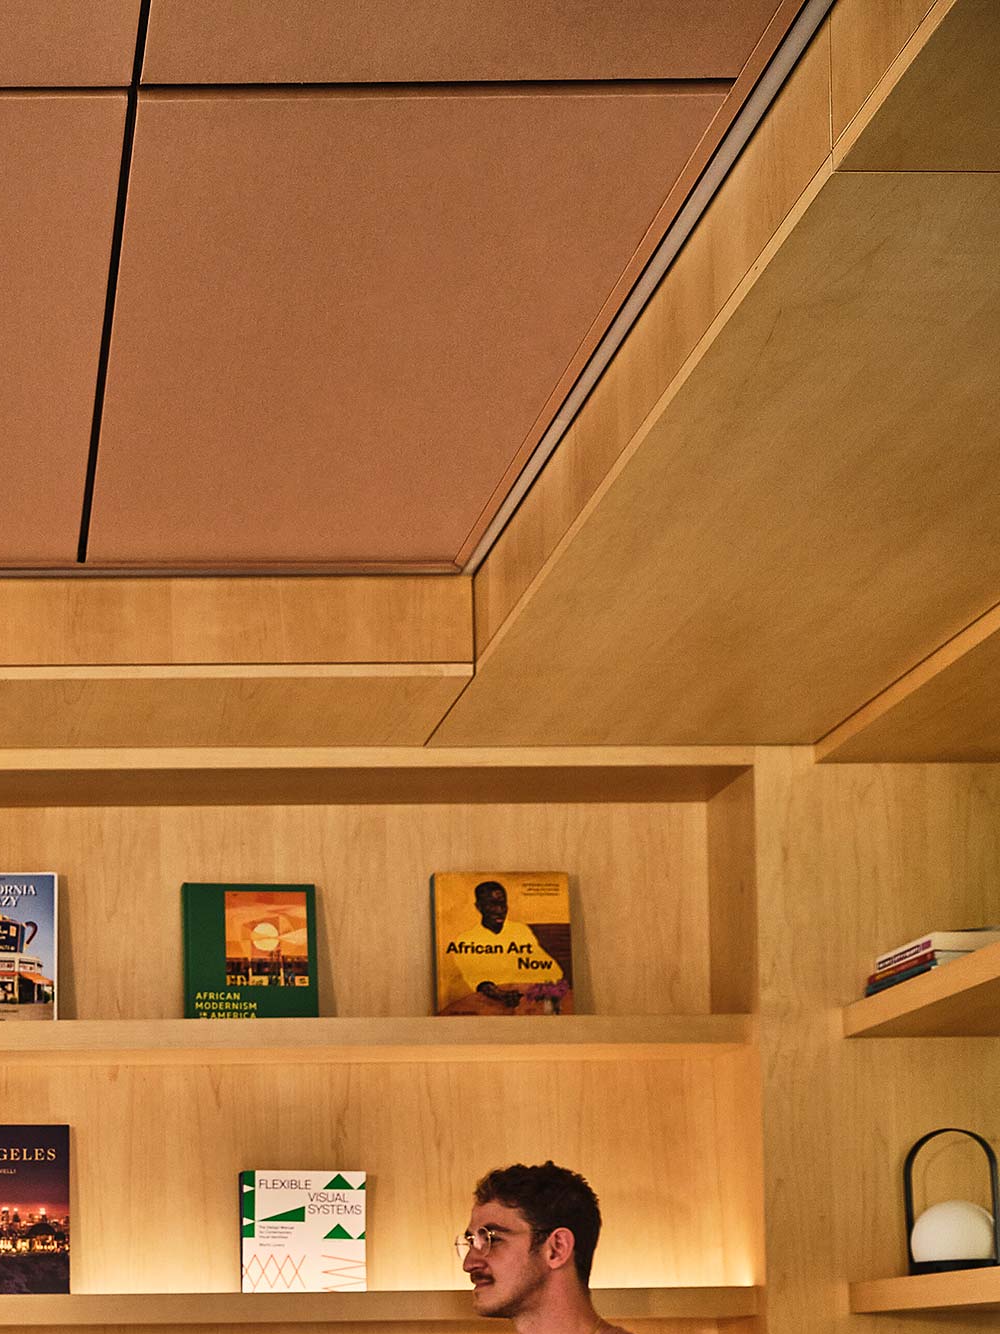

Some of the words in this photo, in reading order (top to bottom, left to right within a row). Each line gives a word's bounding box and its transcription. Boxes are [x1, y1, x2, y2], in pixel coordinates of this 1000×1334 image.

[446, 941, 504, 954] African
[507, 941, 533, 954] Art
[517, 957, 553, 970] Now
[195, 992, 241, 1000] AFRICAN
[194, 1001, 257, 1010] MODERNISM
[258, 1179, 312, 1190] FLEXIBLE
[308, 1192, 349, 1203] VISUAL
[307, 1203, 362, 1215] SYSTEMS
